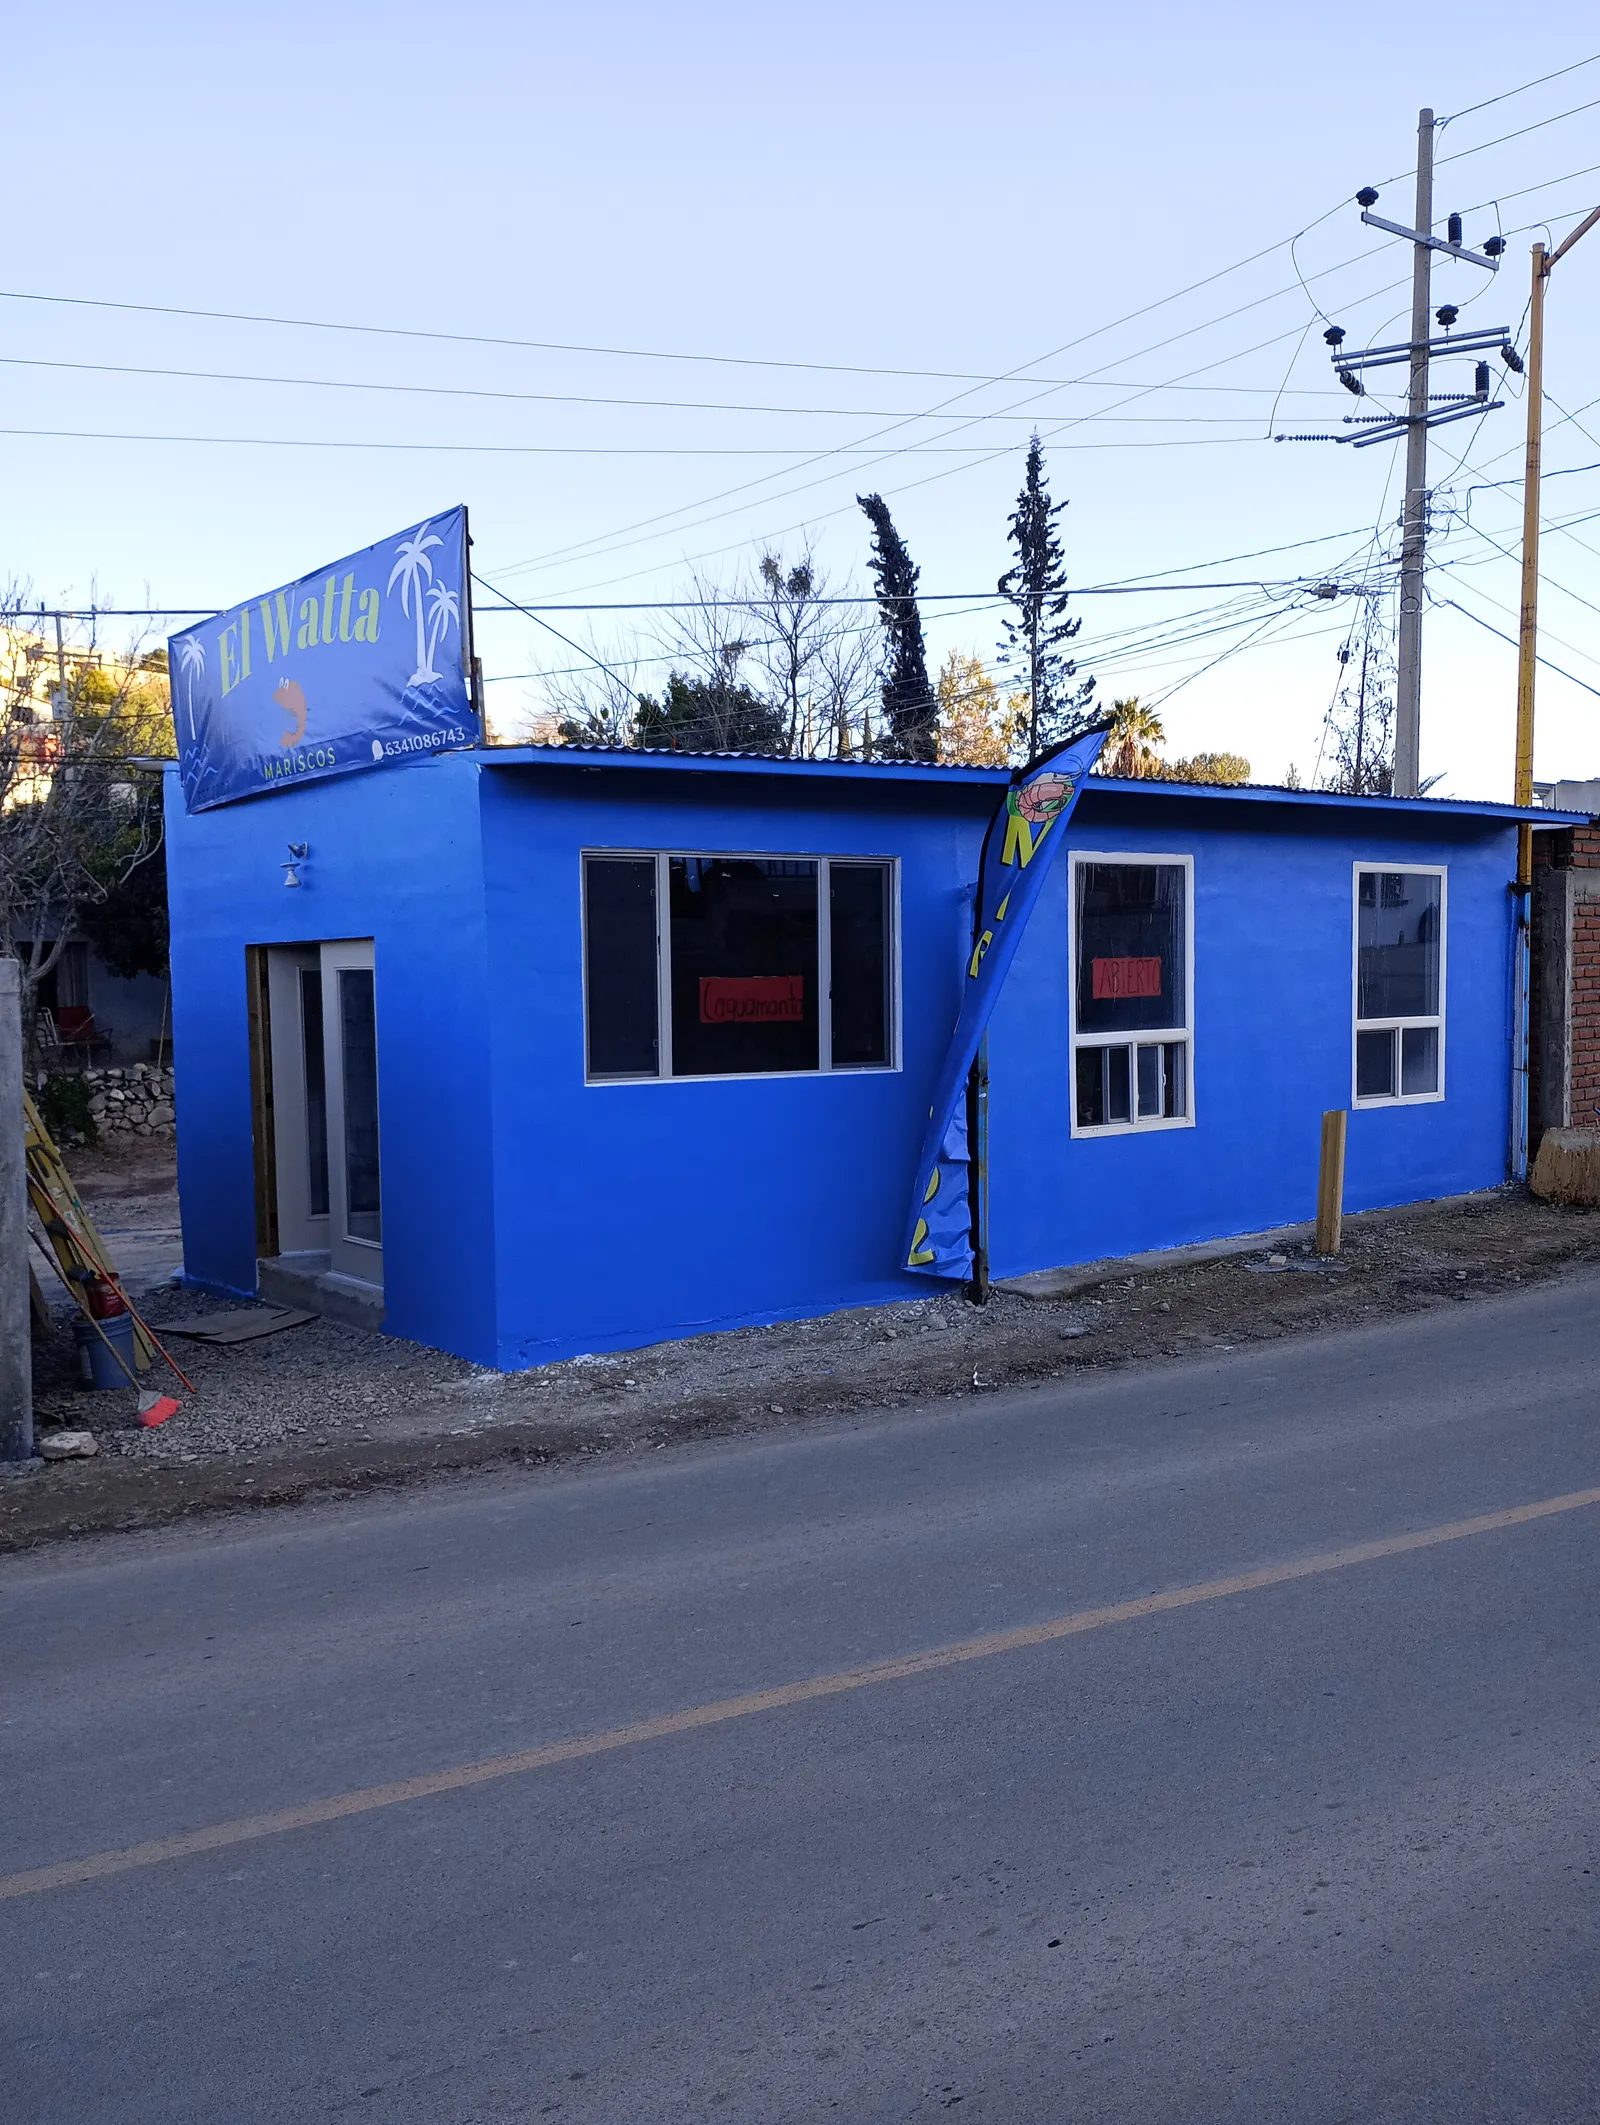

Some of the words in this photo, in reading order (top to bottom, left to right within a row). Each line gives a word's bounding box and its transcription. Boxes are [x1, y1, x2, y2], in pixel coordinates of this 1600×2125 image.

[217, 606, 252, 698] El
[258, 572, 381, 663] Watta
[386, 727, 466, 756] 6341086743
[264, 747, 337, 781] MARISCOS
[1100, 959, 1161, 994] ABIERTO
